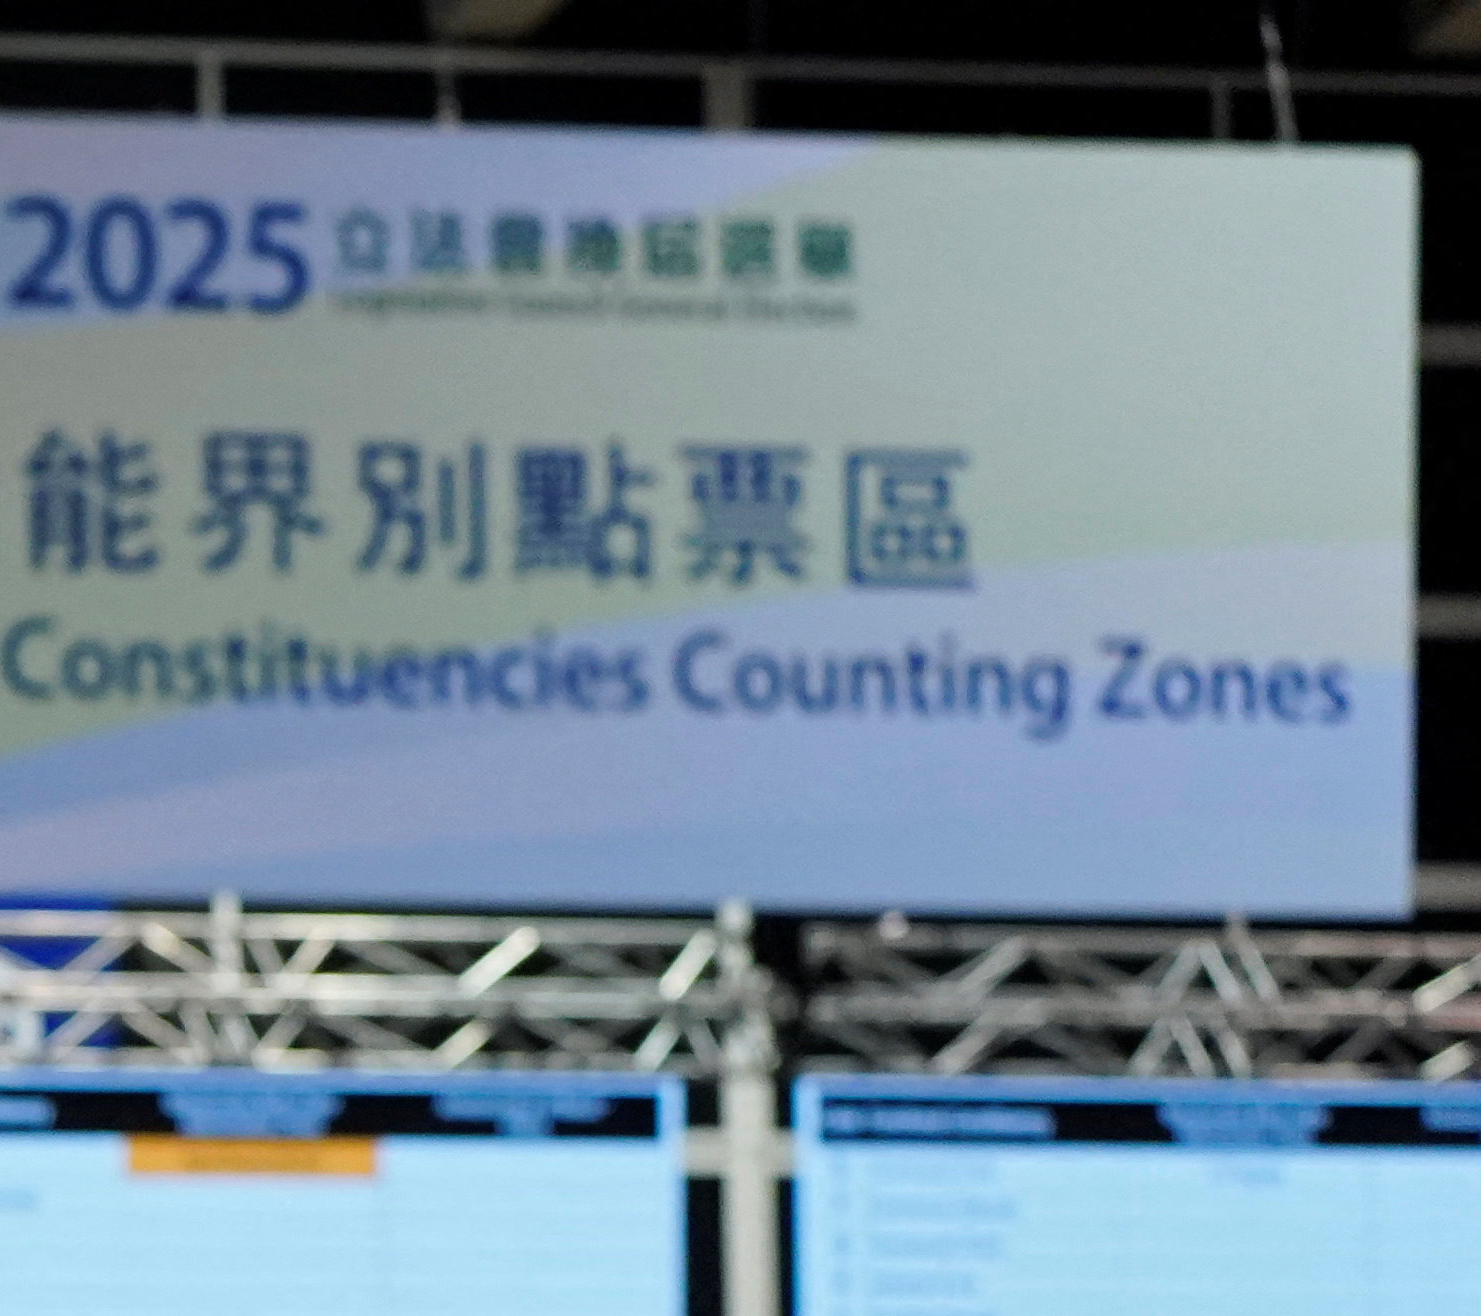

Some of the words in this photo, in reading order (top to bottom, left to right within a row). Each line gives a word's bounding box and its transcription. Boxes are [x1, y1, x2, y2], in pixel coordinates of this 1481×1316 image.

[5, 195, 312, 314] 2025
[1, 610, 649, 714] Constituencies
[672, 627, 1073, 740] Counting
[1097, 636, 1353, 723] Zones
